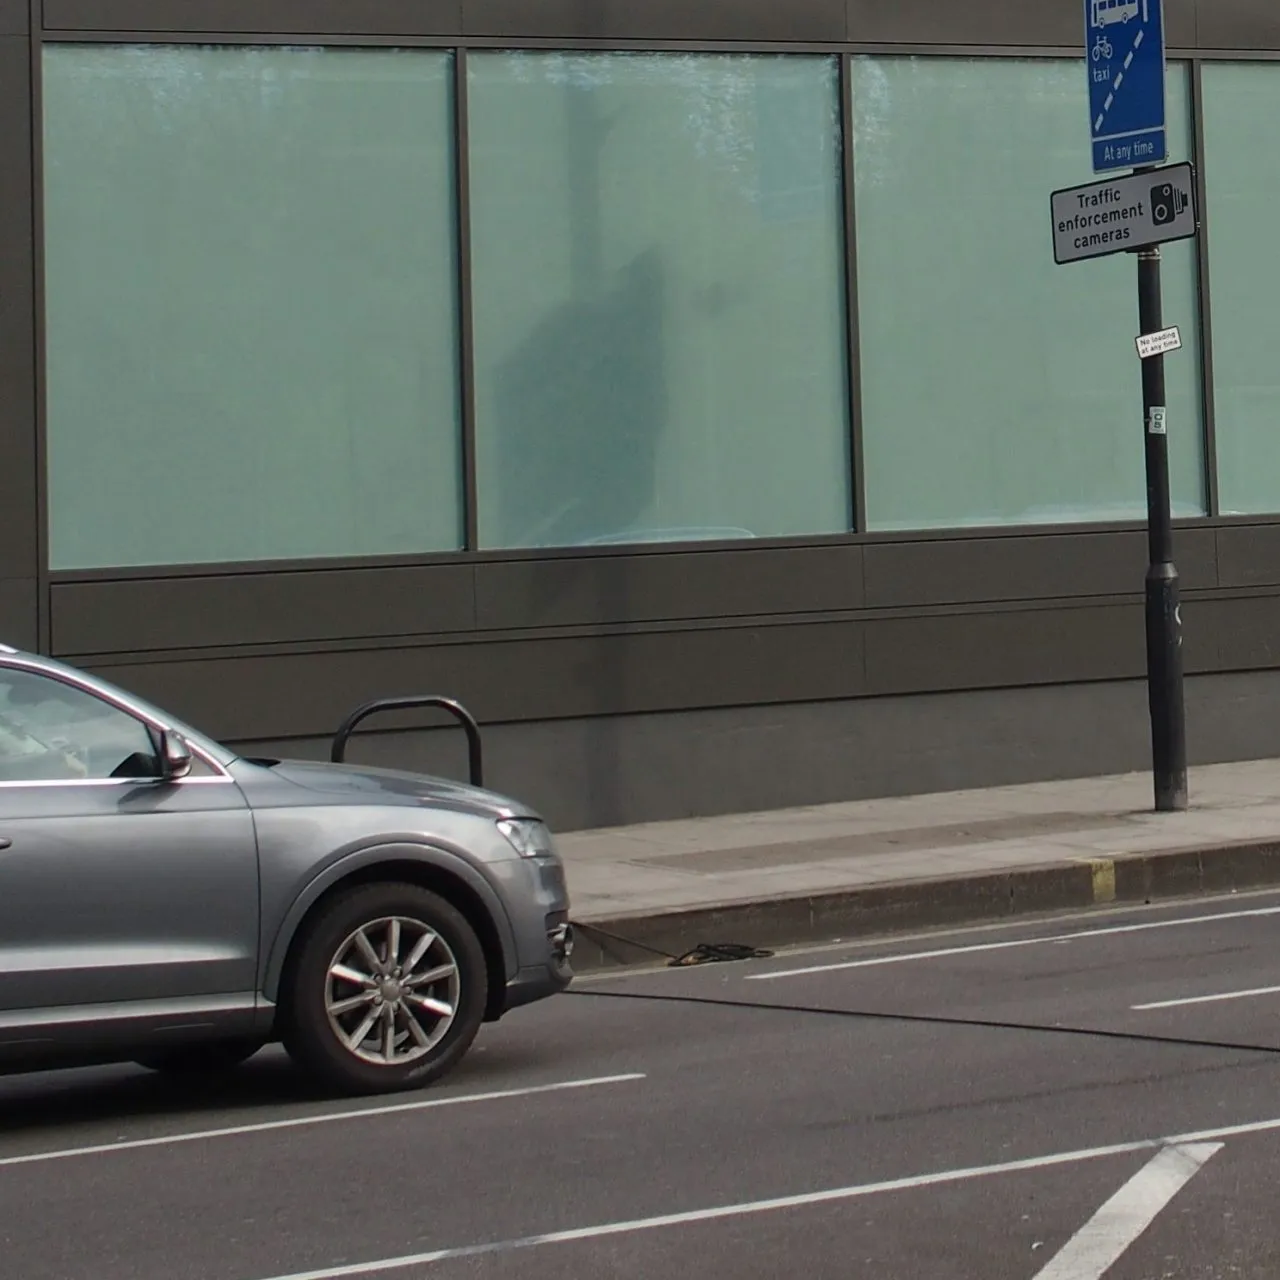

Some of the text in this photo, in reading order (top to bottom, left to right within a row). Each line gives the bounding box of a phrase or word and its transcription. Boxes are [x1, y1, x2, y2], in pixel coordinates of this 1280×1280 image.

[1093, 65, 1110, 82] taxi
[1104, 140, 1154, 161] At any time
[1077, 187, 1121, 209] Traffic
[1058, 202, 1144, 232] enforcement
[1074, 227, 1130, 249] cameras
[1140, 331, 1176, 346] No loading
[1141, 339, 1178, 354] at any time
